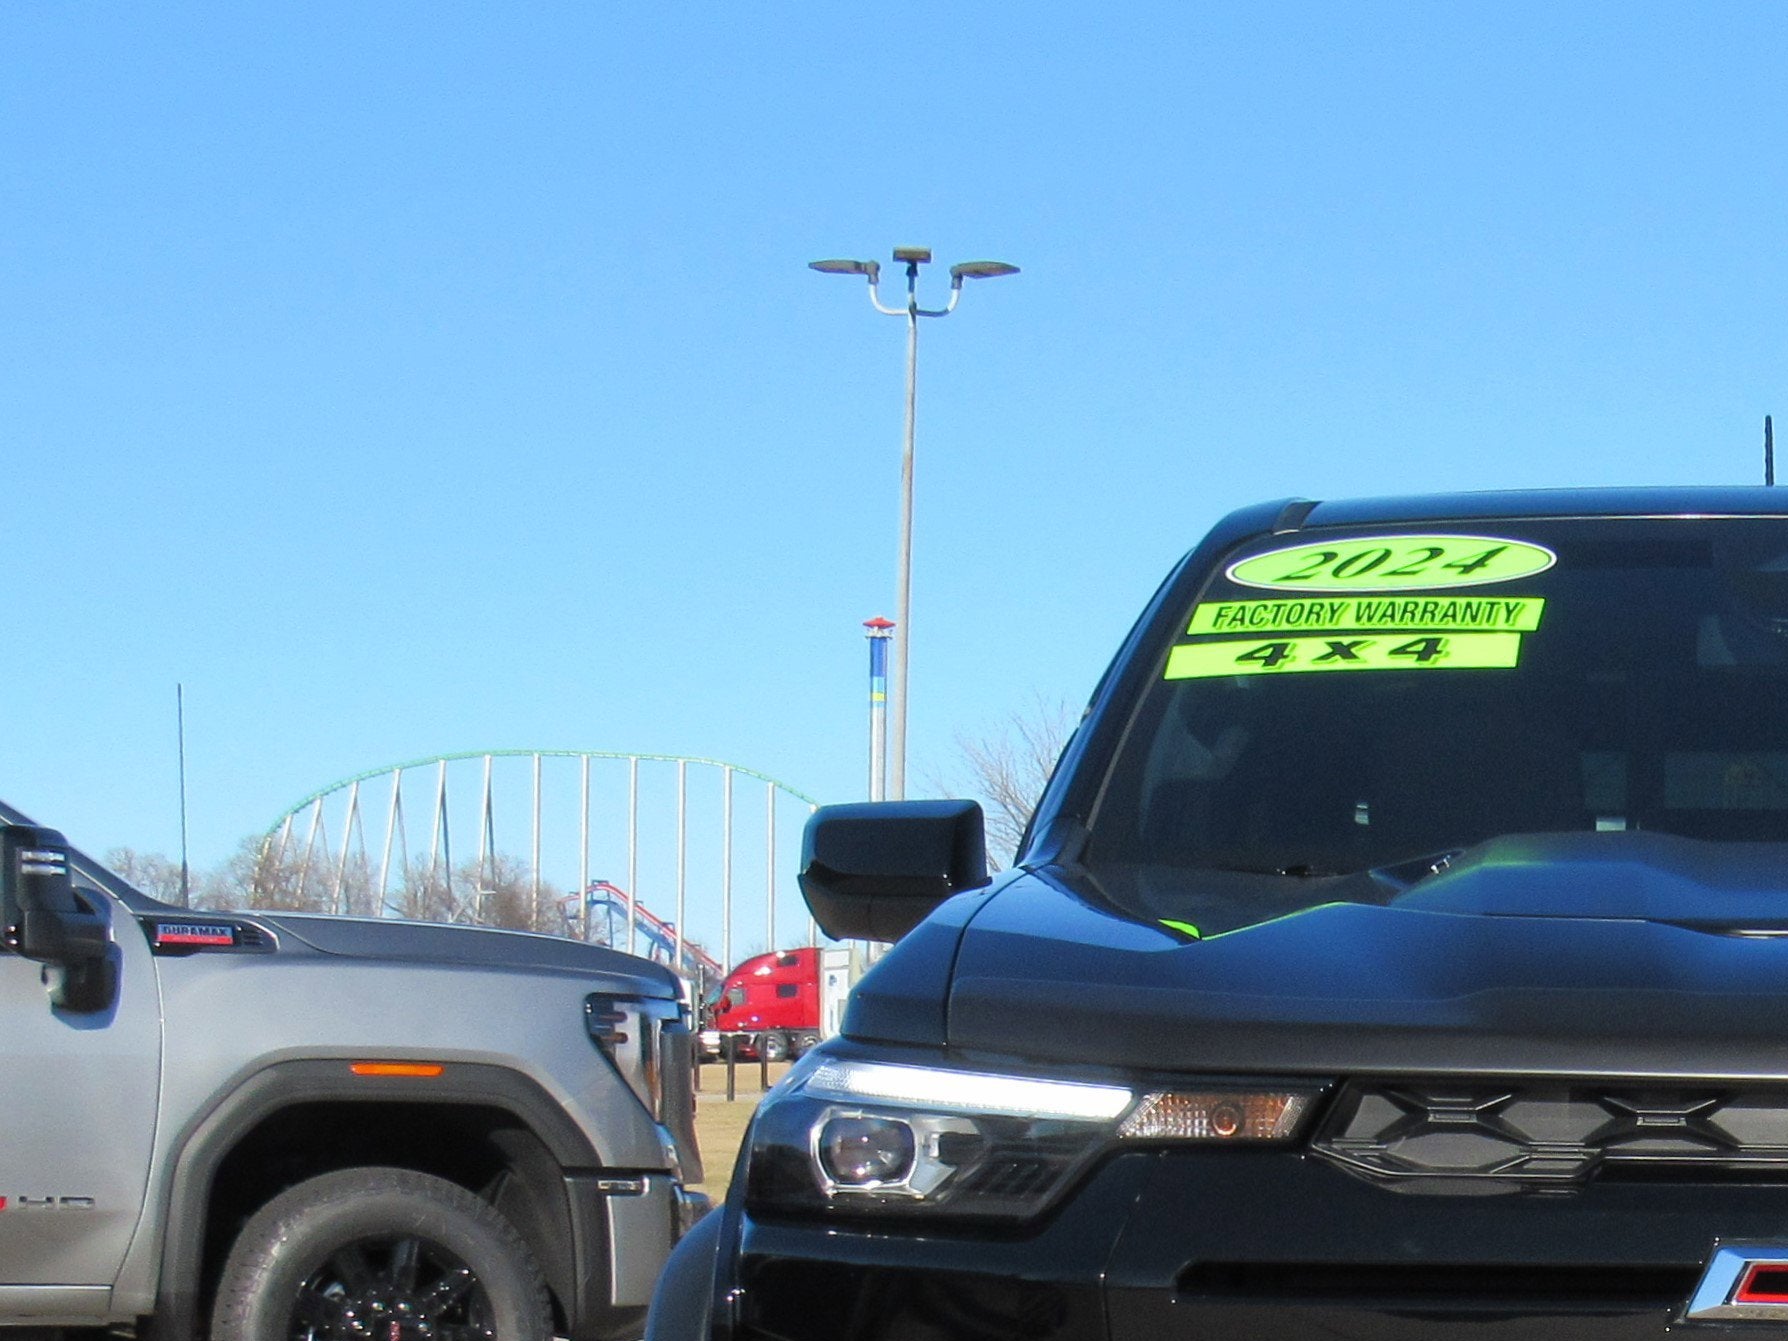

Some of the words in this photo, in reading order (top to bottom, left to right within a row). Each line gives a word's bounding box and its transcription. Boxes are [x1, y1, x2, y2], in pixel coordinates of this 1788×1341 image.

[1272, 545, 1511, 582] 2024
[1212, 600, 1347, 628] FACTORY
[1355, 599, 1523, 626] WARRANTY
